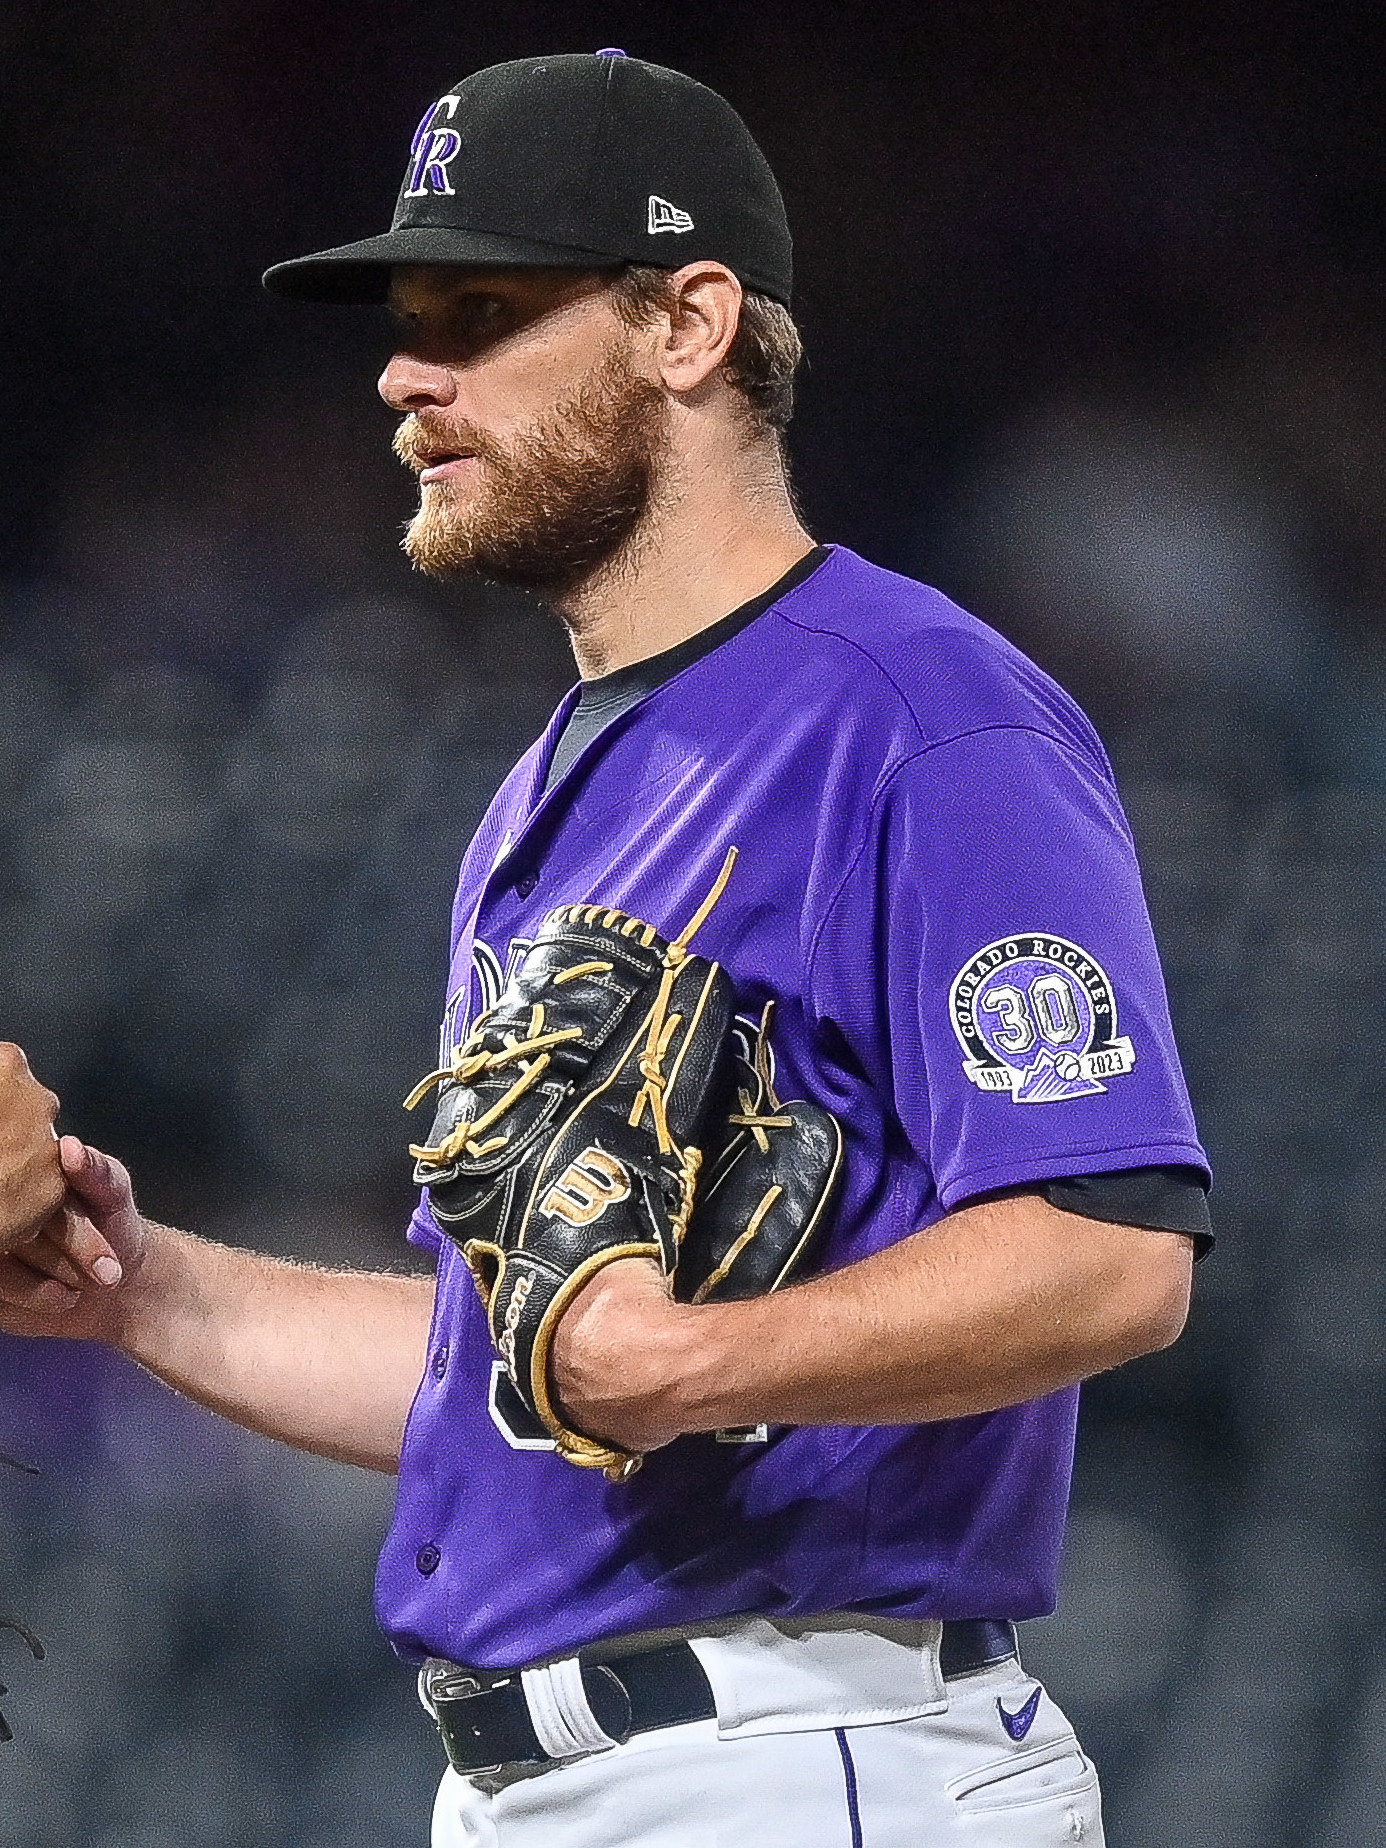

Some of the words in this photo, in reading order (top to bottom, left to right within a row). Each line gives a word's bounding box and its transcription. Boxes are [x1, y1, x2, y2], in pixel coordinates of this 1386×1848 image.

[956, 942, 1019, 1038] COLORADO
[1032, 940, 1110, 1015] ROCKIES
[981, 973, 1082, 1055] 30
[1087, 1051, 1125, 1075] 2023
